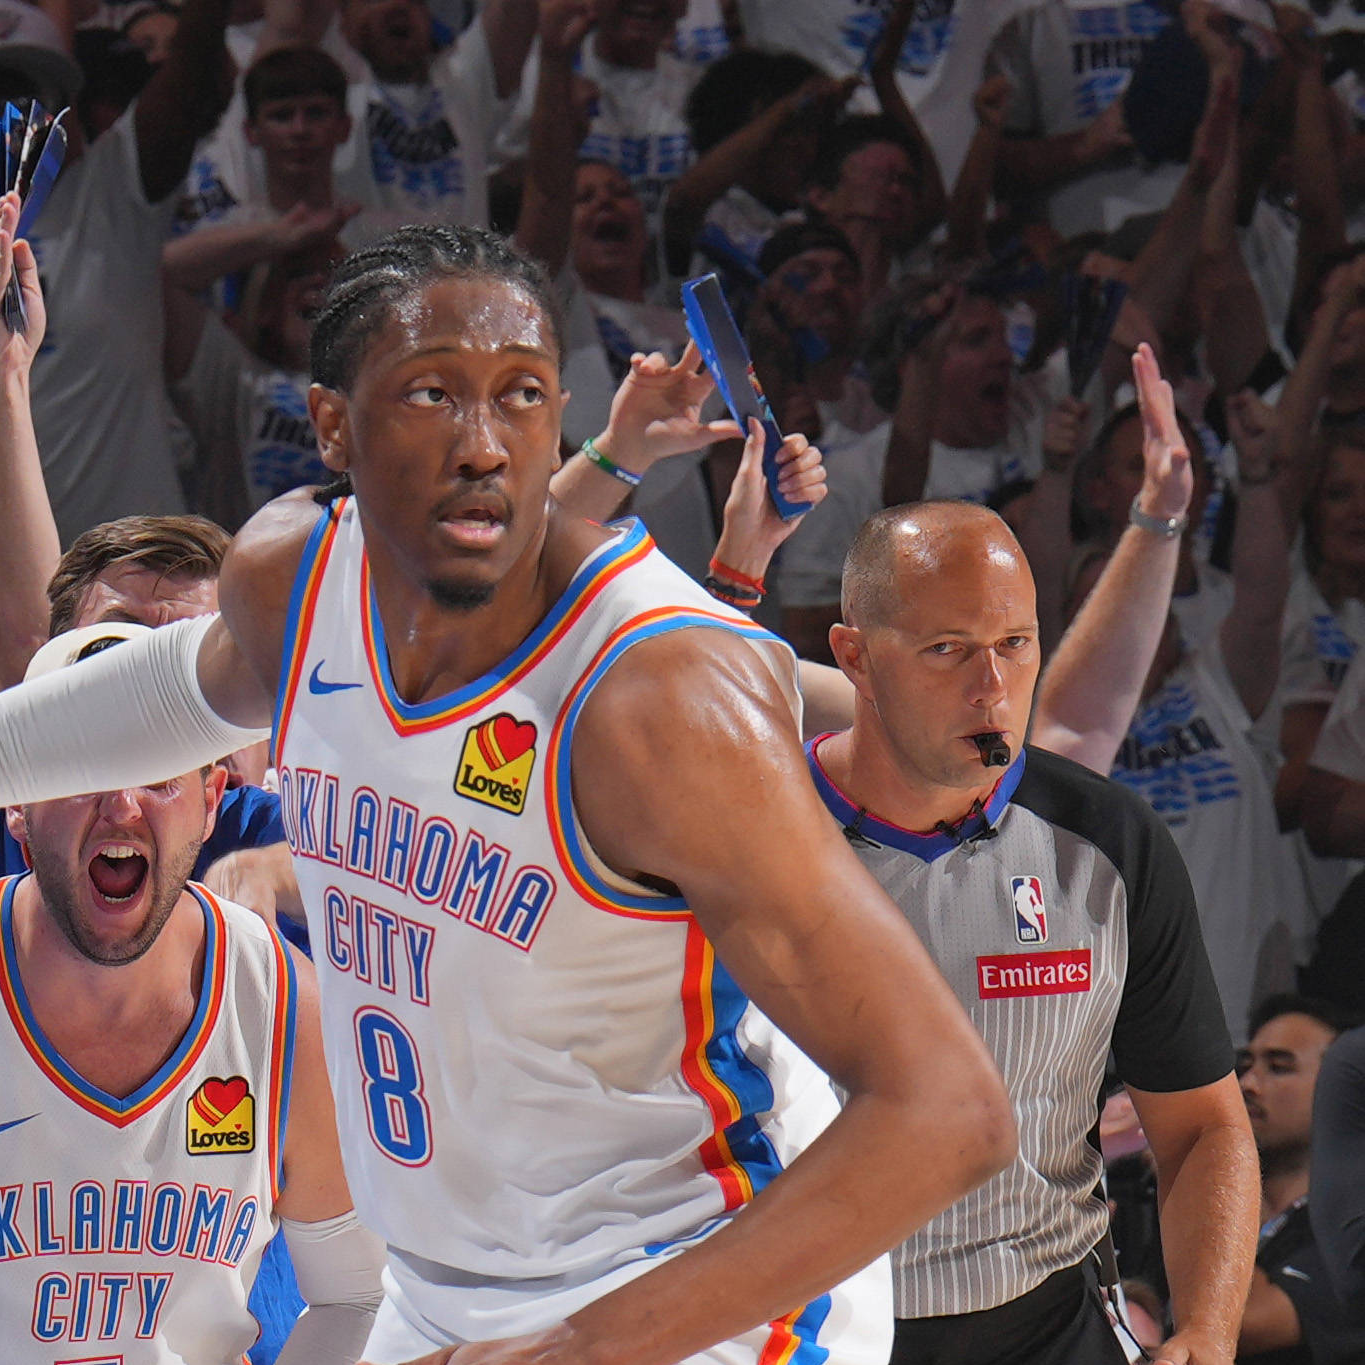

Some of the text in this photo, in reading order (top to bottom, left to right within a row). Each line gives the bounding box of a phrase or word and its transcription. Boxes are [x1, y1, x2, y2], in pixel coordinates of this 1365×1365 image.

[323, 884, 436, 1007] CITY
[981, 961, 1089, 989] Emirates
[353, 1005, 433, 1168] 8
[31, 1272, 173, 1342] CITY
